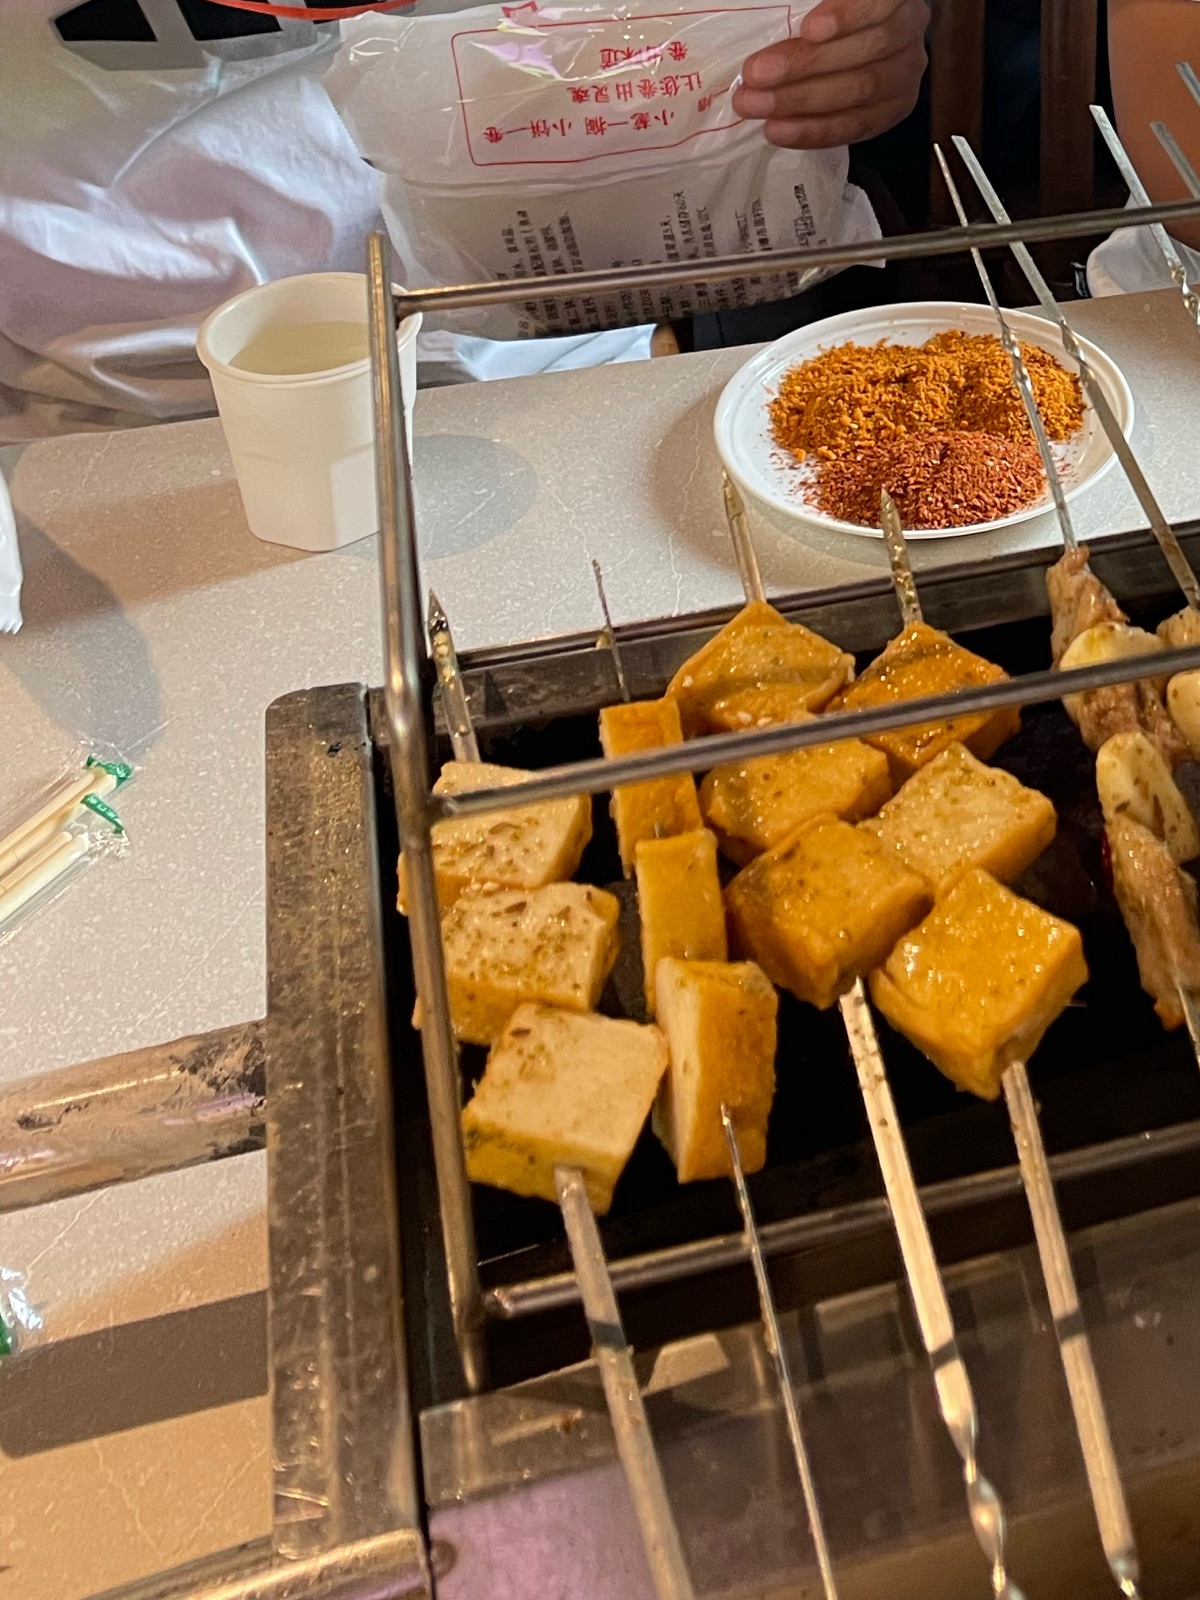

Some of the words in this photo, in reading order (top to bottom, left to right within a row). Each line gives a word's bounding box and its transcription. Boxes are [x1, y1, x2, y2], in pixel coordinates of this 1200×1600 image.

[566, 71, 702, 104] 让您卷出灵魂
